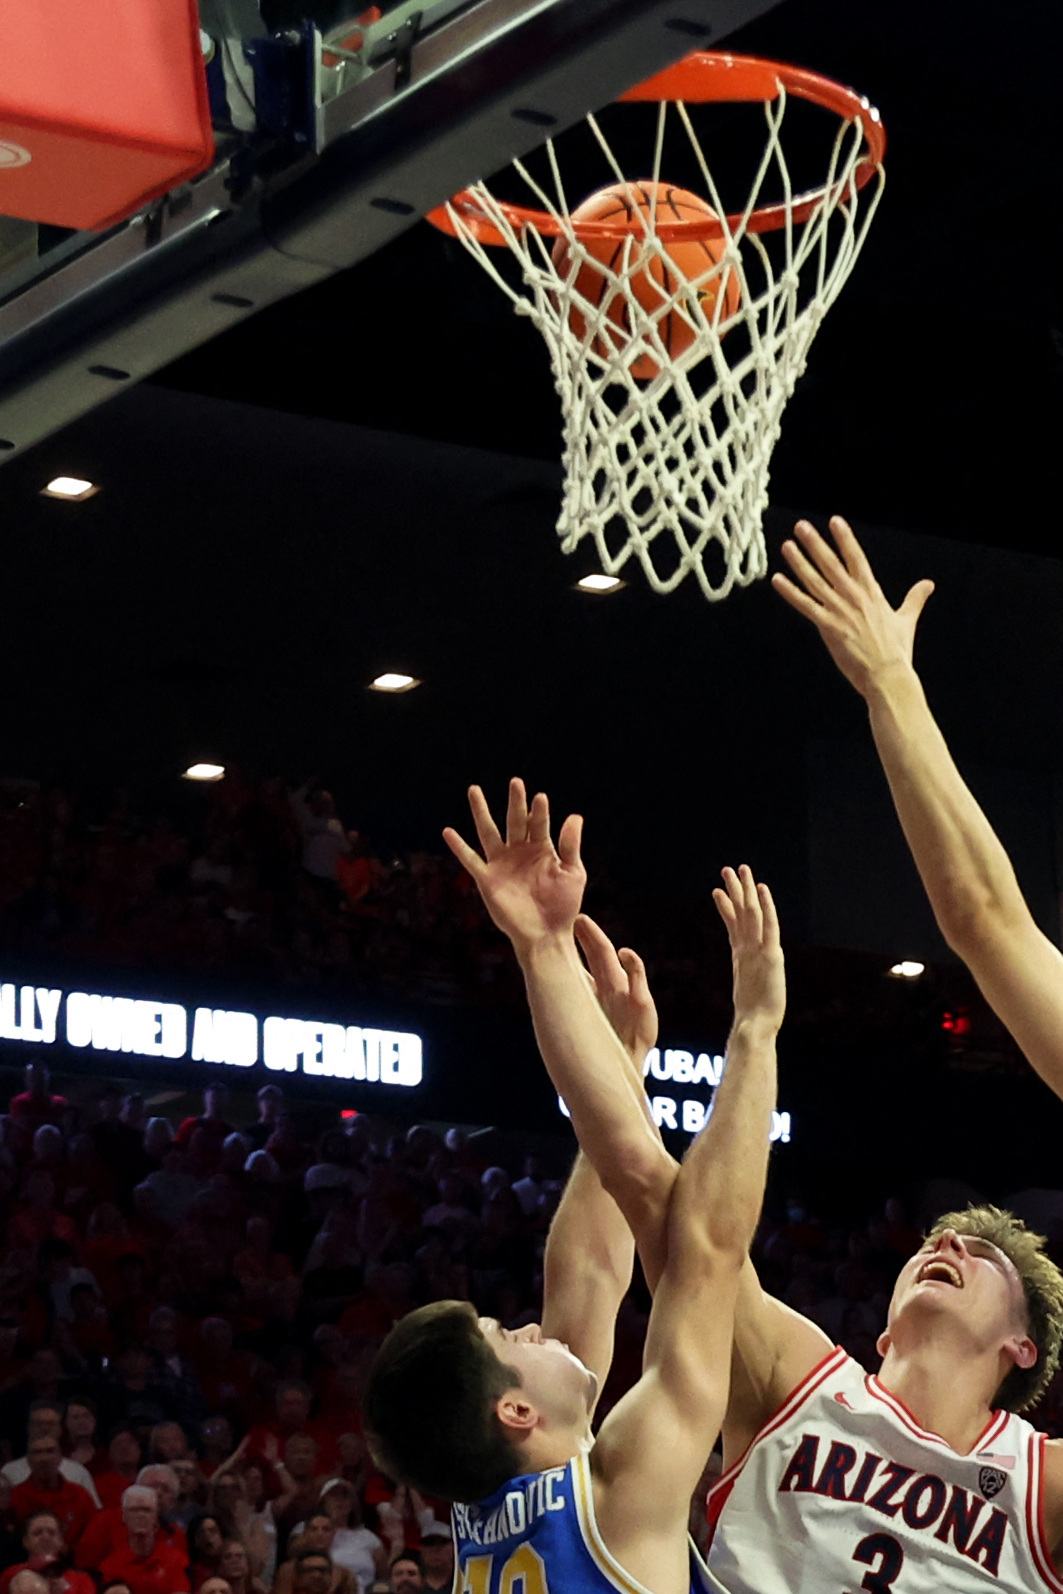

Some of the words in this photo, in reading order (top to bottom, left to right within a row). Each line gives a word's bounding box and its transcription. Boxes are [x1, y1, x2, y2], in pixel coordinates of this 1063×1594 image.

[0, 983, 62, 1044] LLY
[66, 992, 187, 1059] OWNED
[191, 1007, 258, 1067] AND
[263, 1016, 422, 1087] OPERATED
[778, 1433, 1009, 1578] ARIZONA
